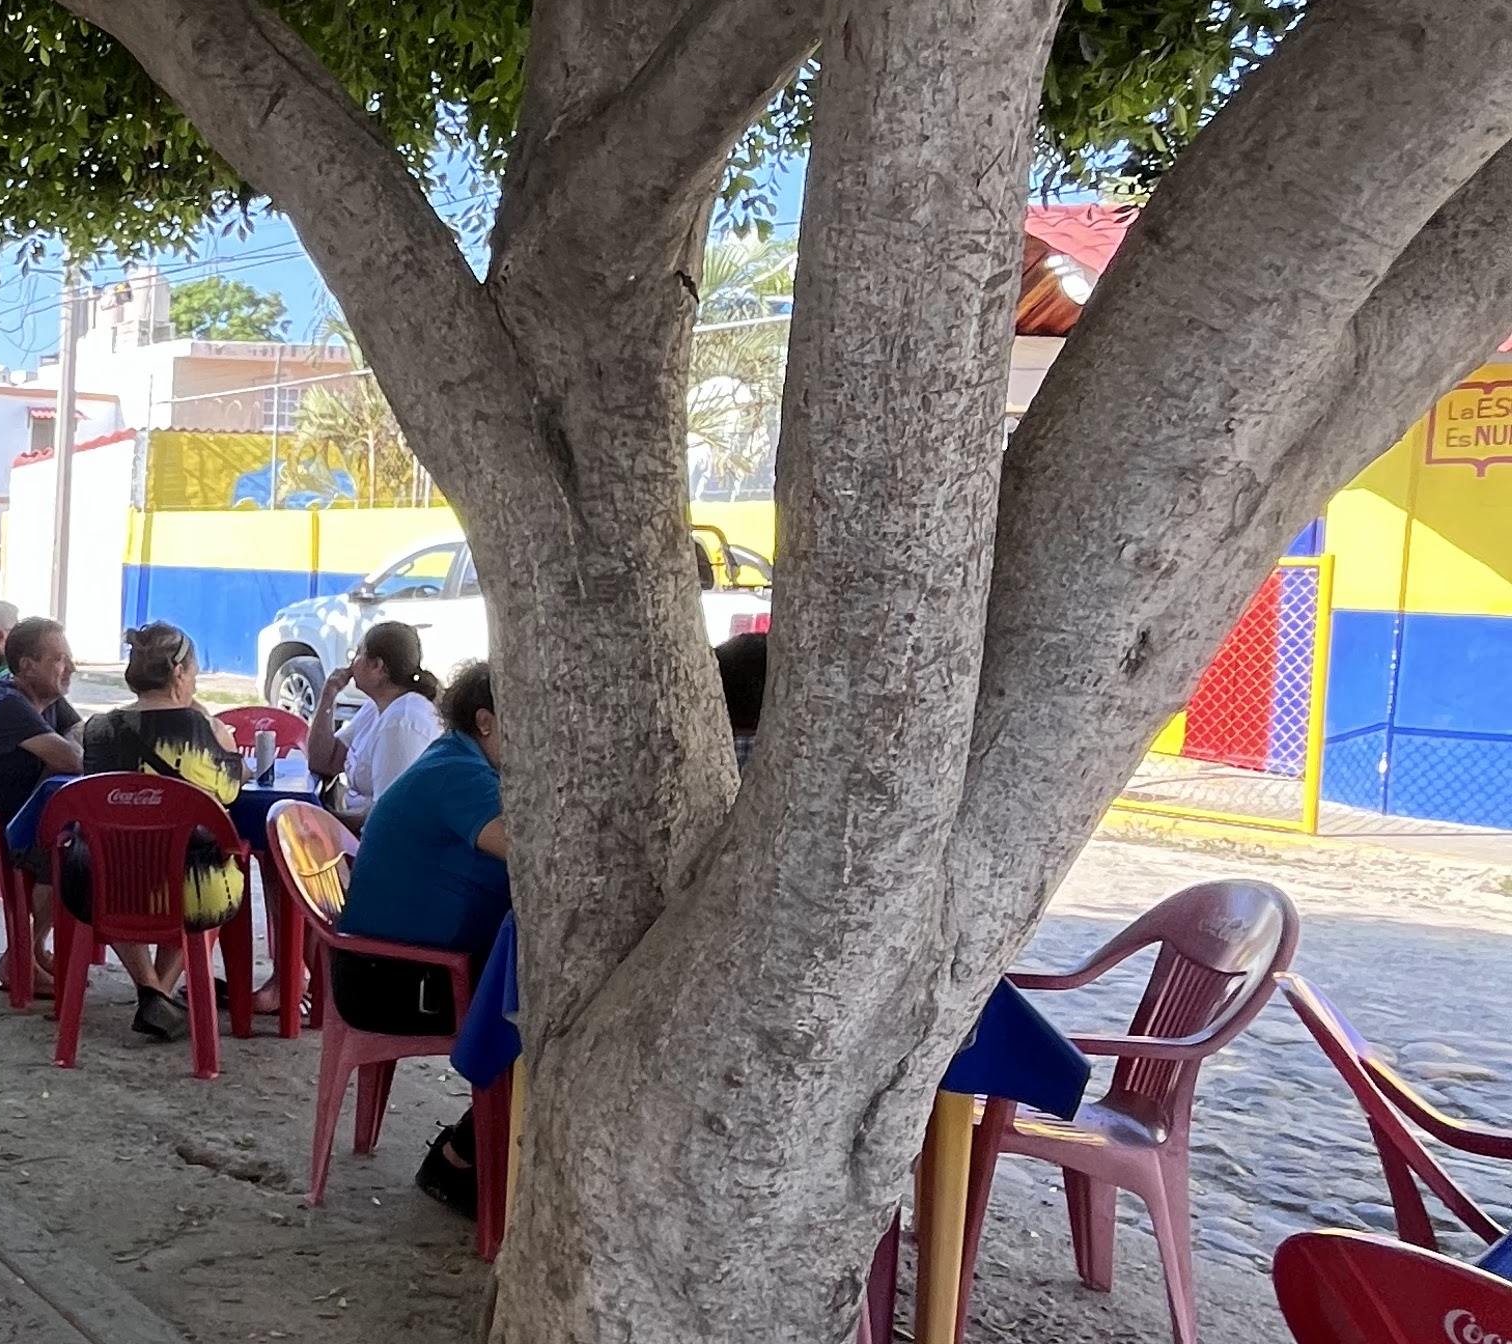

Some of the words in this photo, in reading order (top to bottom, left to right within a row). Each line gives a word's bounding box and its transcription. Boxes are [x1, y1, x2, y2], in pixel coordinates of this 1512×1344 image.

[1448, 401, 1474, 421] La
[1476, 397, 1512, 419] ES
[1446, 427, 1472, 448] Es
[1474, 424, 1512, 448] NU
